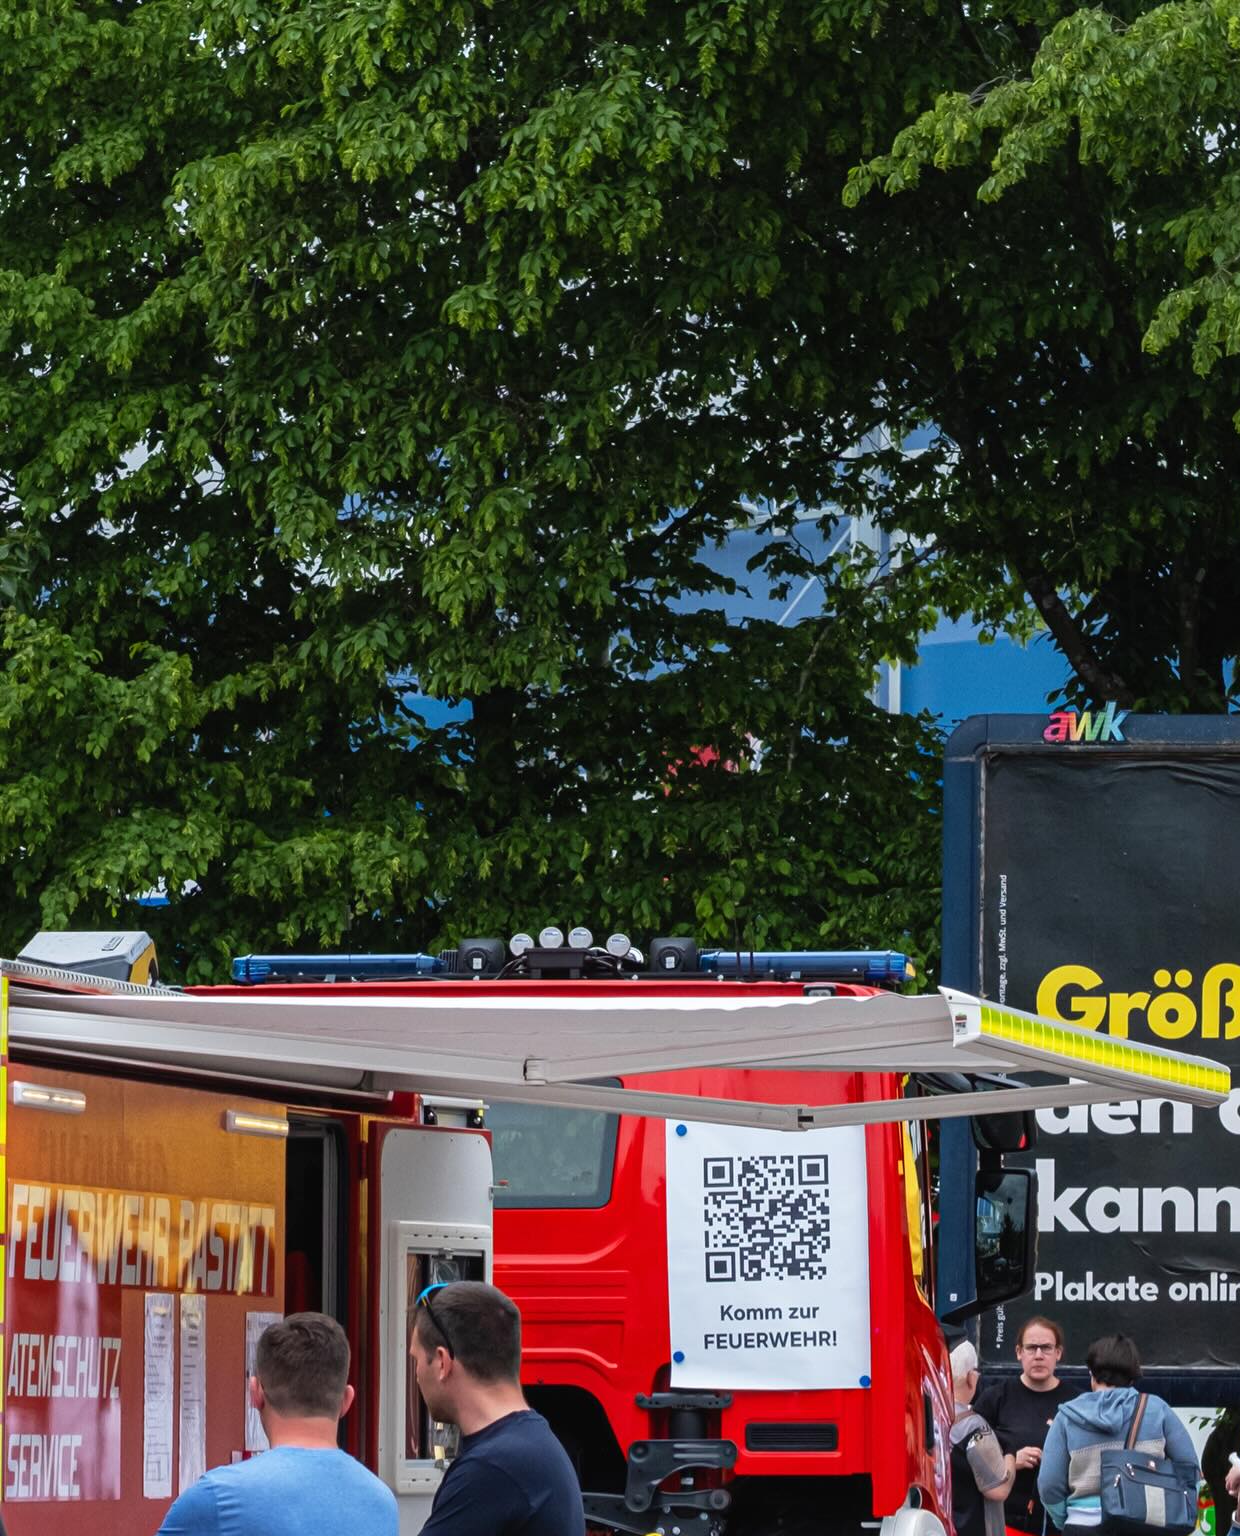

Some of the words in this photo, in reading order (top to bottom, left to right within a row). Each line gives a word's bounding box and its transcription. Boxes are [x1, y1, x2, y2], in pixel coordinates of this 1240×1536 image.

[1043, 700, 1132, 742] awk
[8, 1183, 170, 1288] FEUERWEHR
[1034, 1271, 1159, 1301] Plakate
[720, 1304, 783, 1321] Komm
[788, 1306, 820, 1320] zur
[704, 1330, 838, 1350] FEUERWEHR!
[8, 1333, 122, 1398] ATEMSCHUTZ
[6, 1434, 82, 1498] SERVICE
